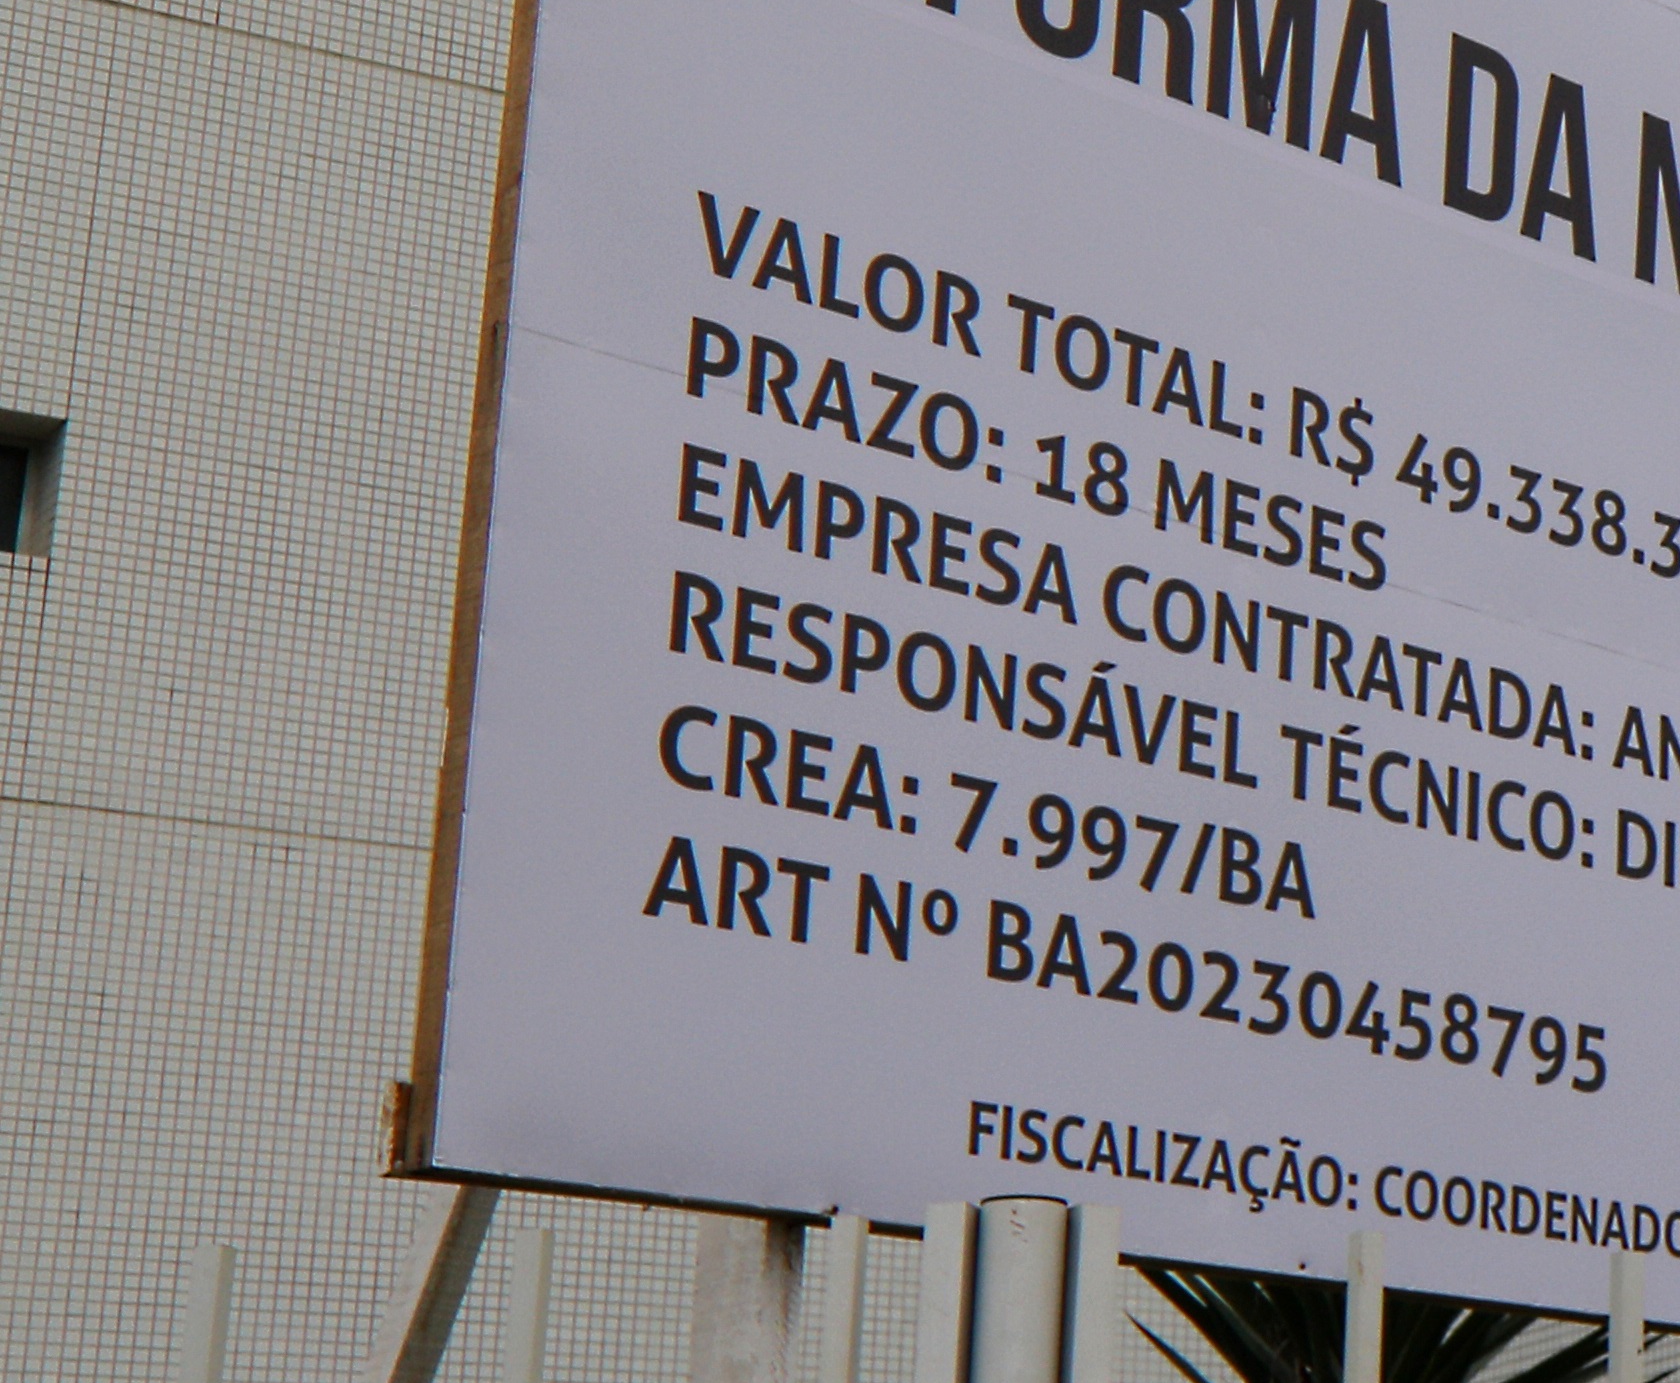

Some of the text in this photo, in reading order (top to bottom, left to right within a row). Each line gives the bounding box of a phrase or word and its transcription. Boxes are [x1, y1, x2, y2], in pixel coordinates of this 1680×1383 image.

[1443, 32, 1597, 263] DA
[686, 317, 1387, 591] PRAZO: 18 MESES
[697, 190, 982, 357] VALOR
[1008, 293, 1265, 444] TOTAL:
[1289, 386, 1375, 487] R$
[668, 570, 1259, 789] RESPONSÁVEL
[1280, 723, 1595, 868] TÉCNICO:
[676, 442, 1078, 625] EMPRESA
[1103, 564, 1595, 761] CONTRATADA:
[658, 704, 1316, 920] CREA: 7.997/BA
[643, 835, 1607, 1093] ART Nº BA20230458795
[967, 1099, 1359, 1212] FISCALIZAÇÃO:
